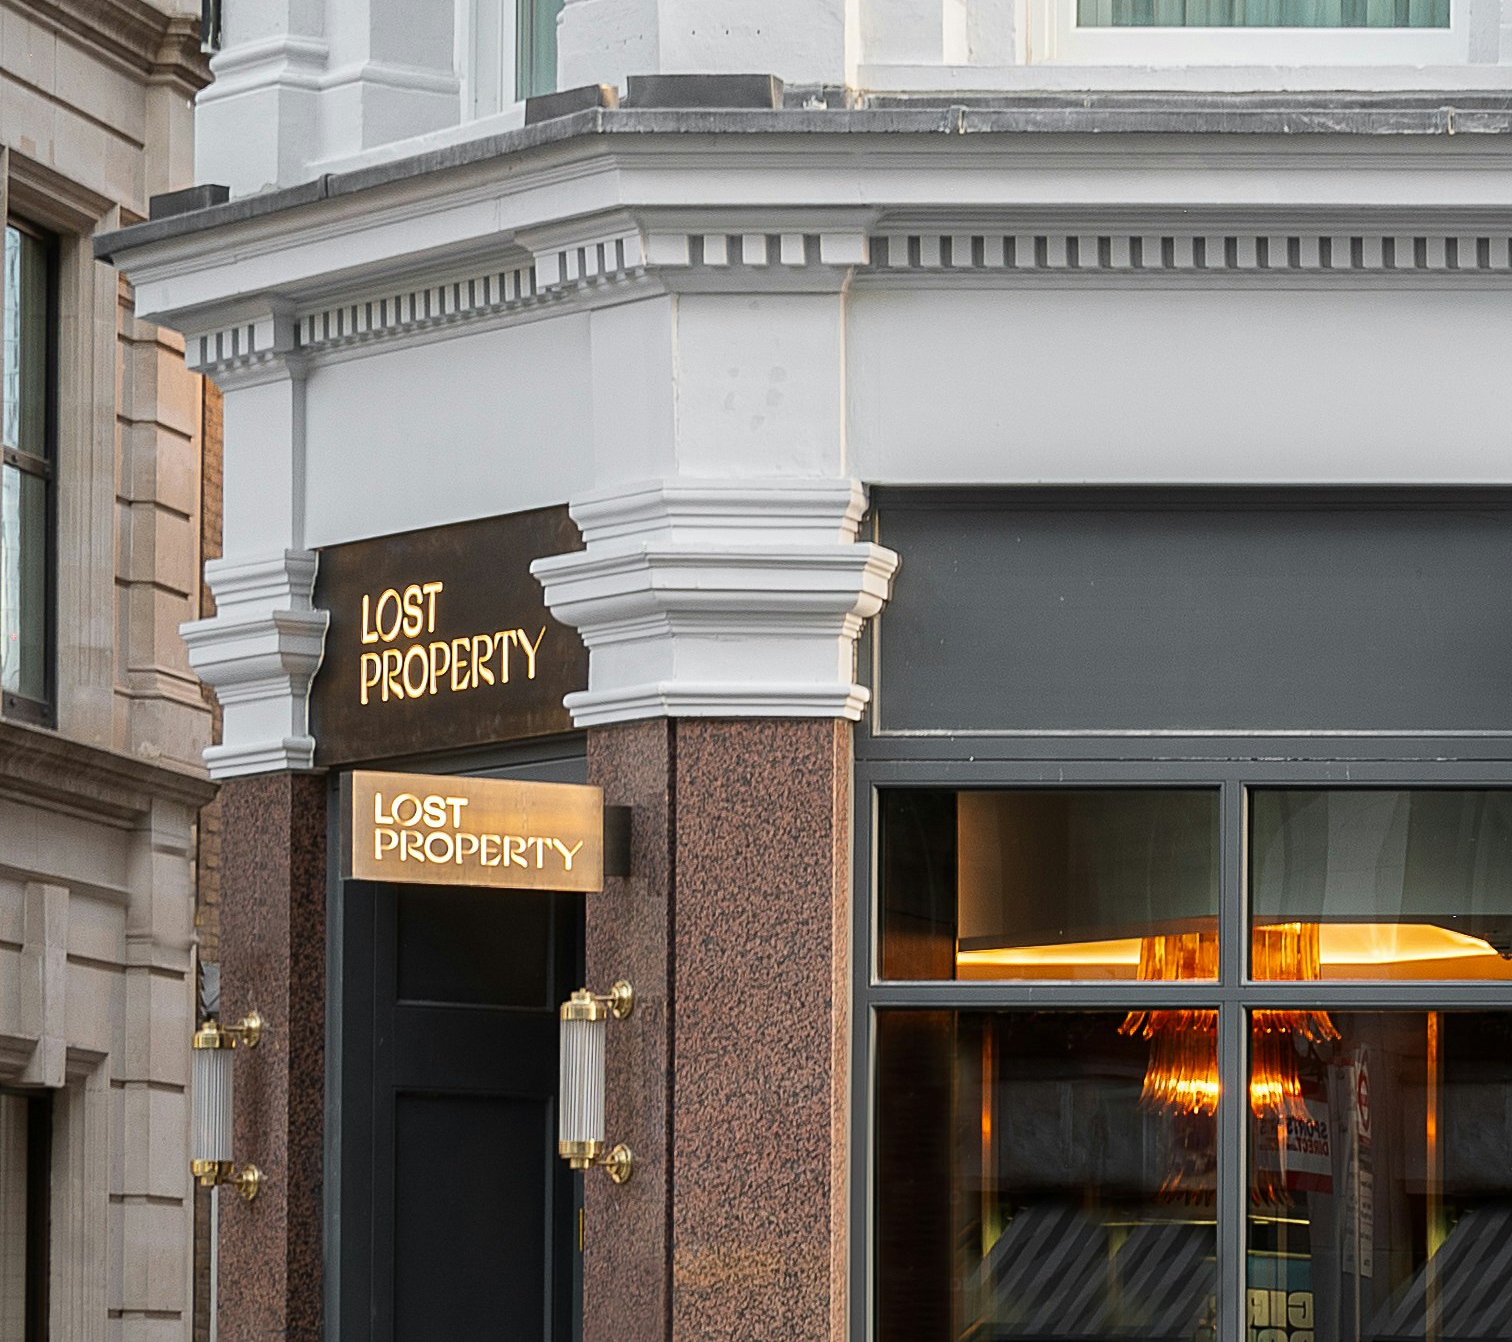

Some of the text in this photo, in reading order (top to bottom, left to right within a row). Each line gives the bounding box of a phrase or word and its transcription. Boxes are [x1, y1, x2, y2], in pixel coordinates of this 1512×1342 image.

[361, 581, 443, 645] LOST
[361, 625, 546, 705] PROPERTY
[374, 792, 469, 829] LOST
[374, 827, 584, 871] PROPERTY
